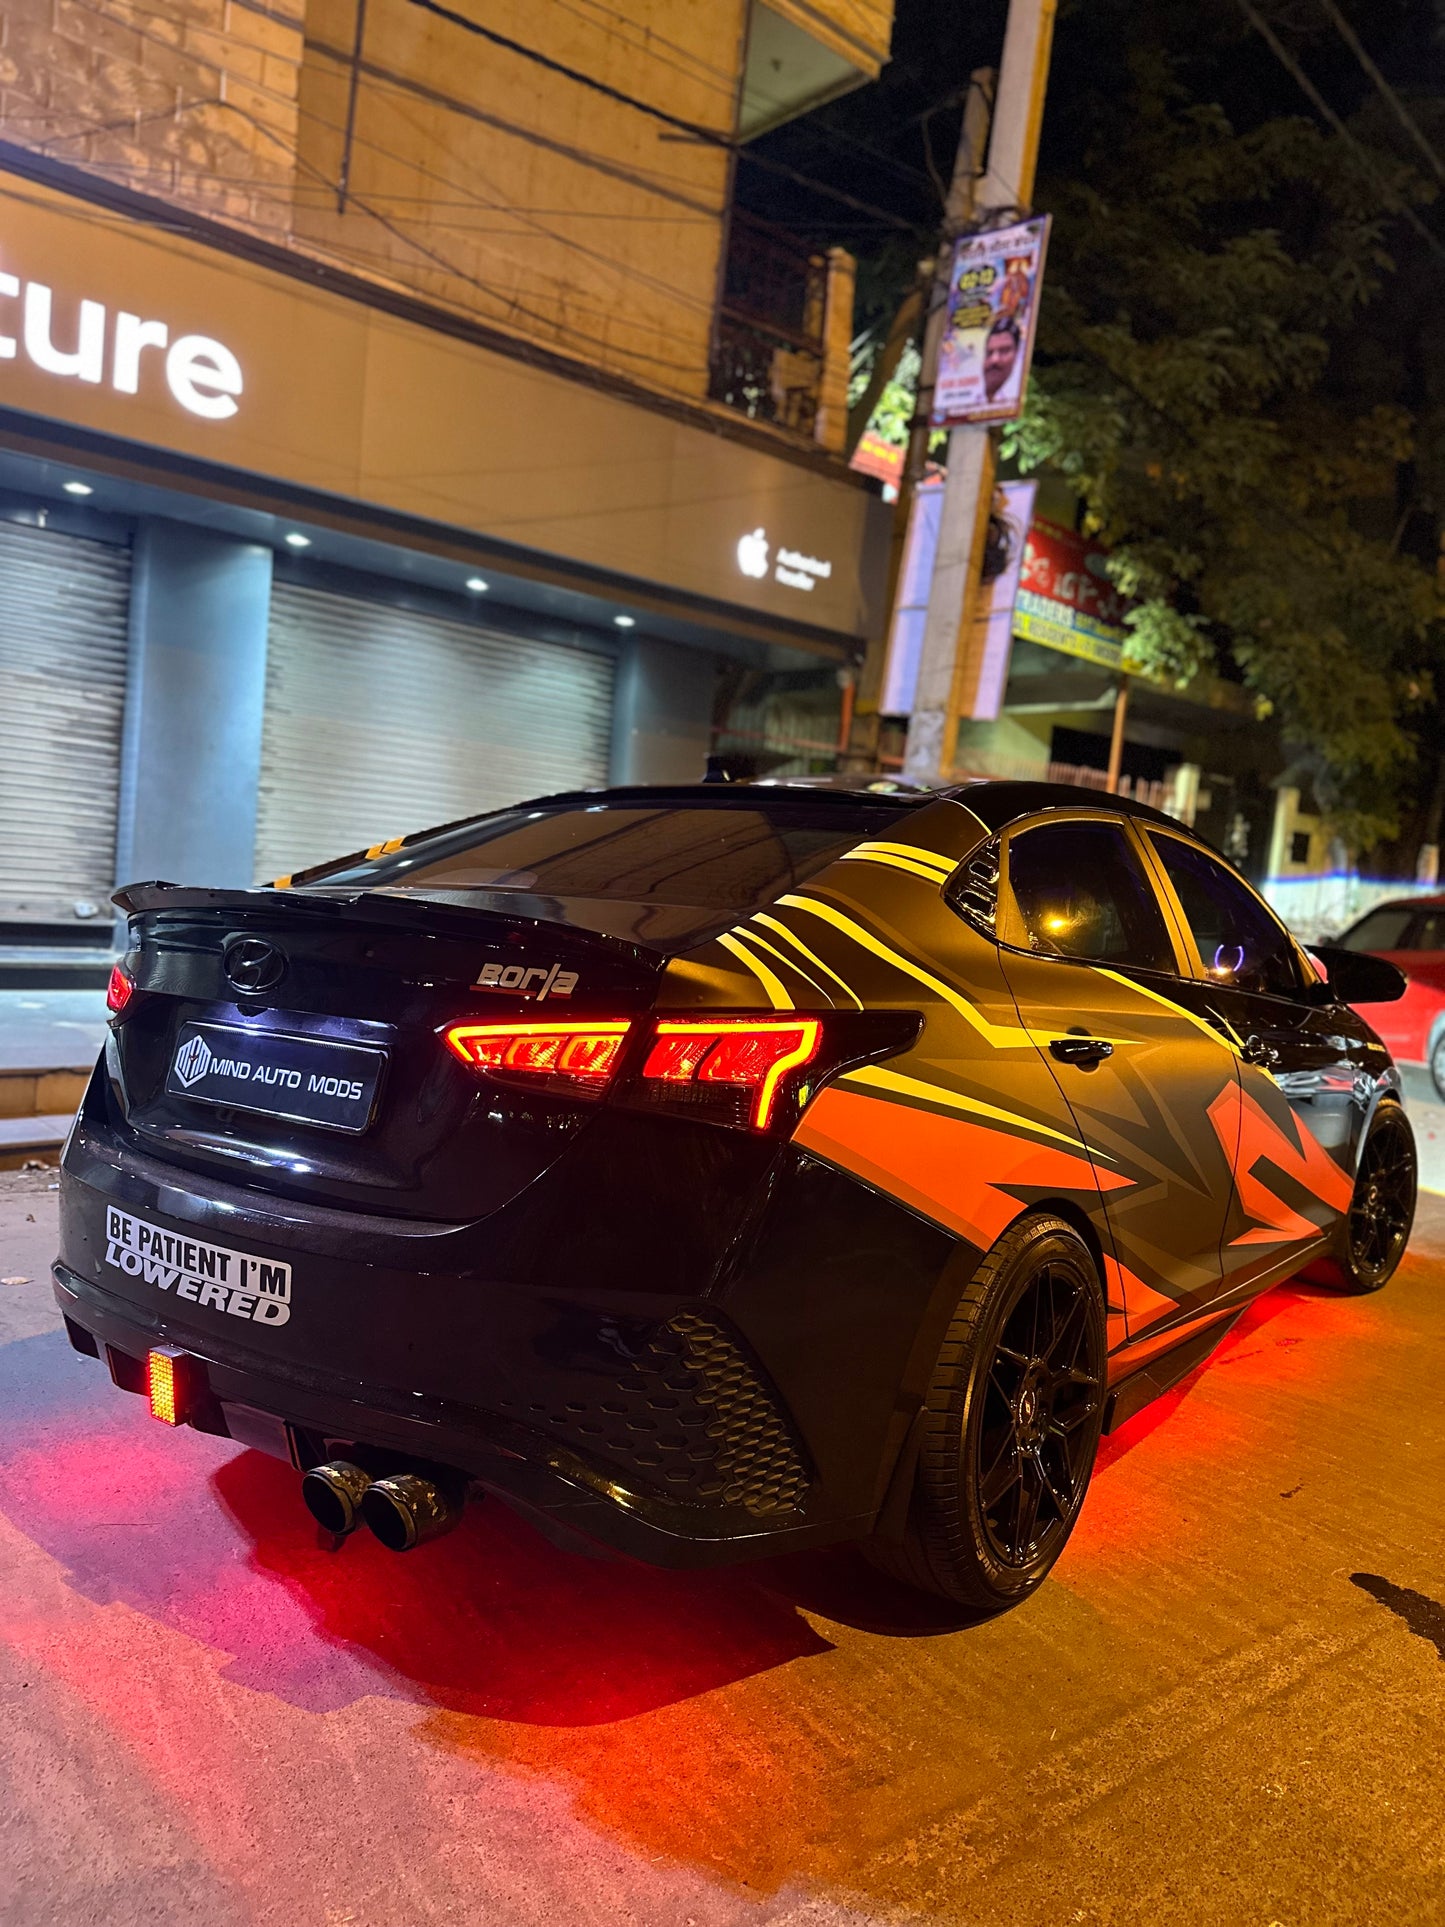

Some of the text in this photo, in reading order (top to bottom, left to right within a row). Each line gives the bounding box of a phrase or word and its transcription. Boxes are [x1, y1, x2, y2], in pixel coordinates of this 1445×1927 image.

[210, 1058, 364, 1100] MIND AUTO MODS
[105, 1242, 290, 1326] LOWERED
[110, 1212, 286, 1297] BE PATIENT I'M
